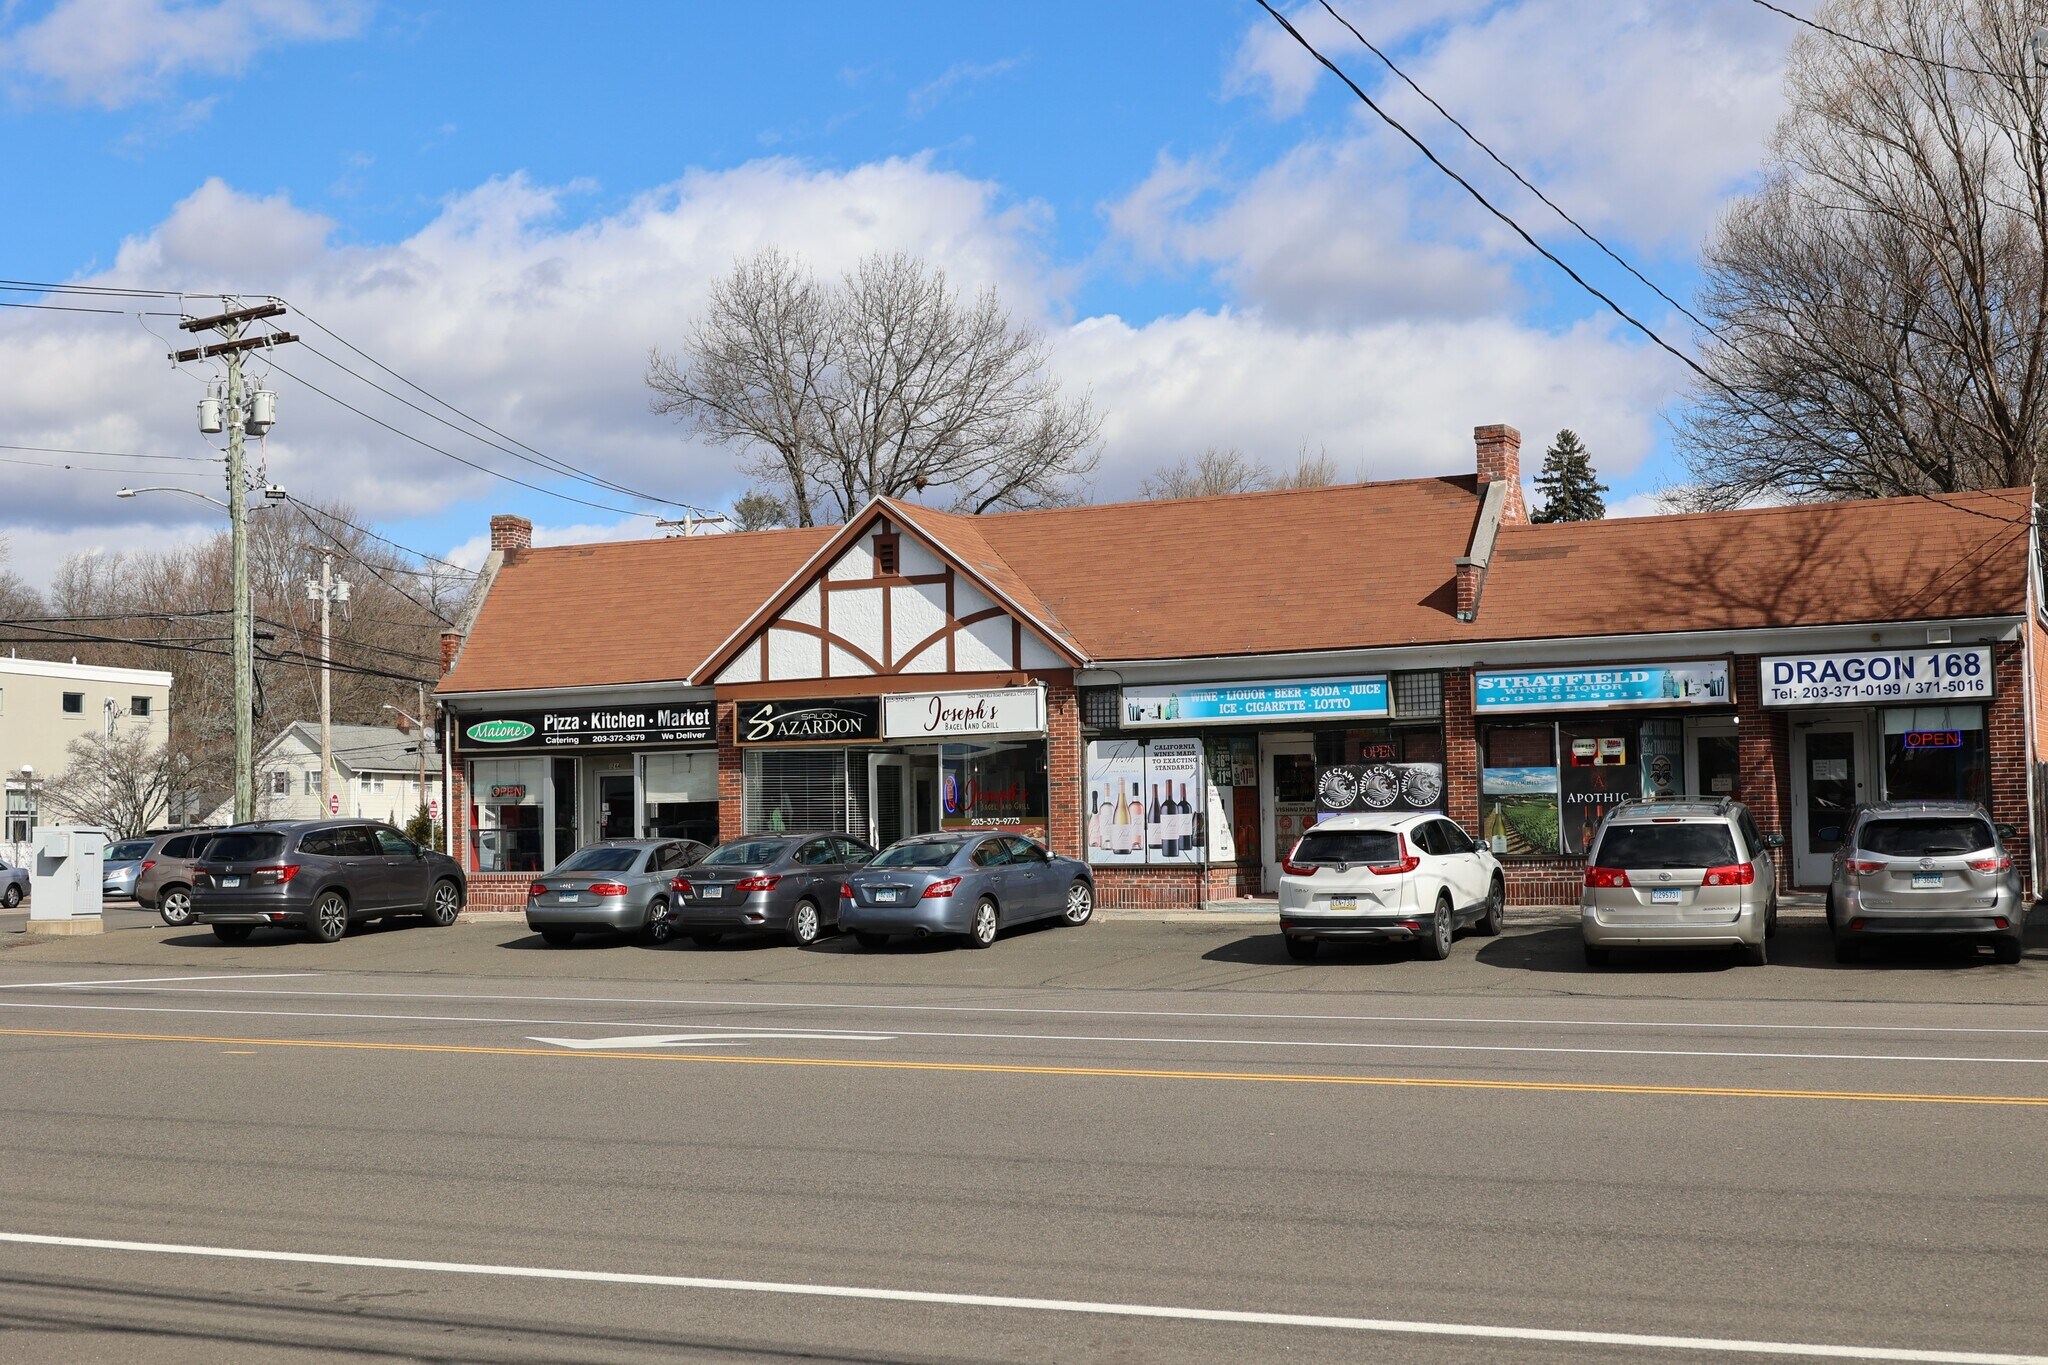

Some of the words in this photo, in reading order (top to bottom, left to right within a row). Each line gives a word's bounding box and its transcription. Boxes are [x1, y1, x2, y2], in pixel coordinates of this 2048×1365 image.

[1773, 656, 1915, 685] DRAGON
[1927, 653, 1981, 678] 168
[1477, 671, 1650, 690] STRATFIELD
[1191, 692, 1218, 702] WINE
[1226, 689, 1265, 701] LIQUOR
[1274, 688, 1302, 699] BEER
[1310, 686, 1340, 697] SODA
[1349, 684, 1381, 695] JUICE
[1504, 687, 1547, 695] WINE
[1565, 683, 1622, 692] LIQUOR
[1771, 688, 1797, 699] Tel:
[1802, 683, 1901, 699] 203-371-0199
[1915, 679, 1984, 694] 371-5016
[924, 696, 999, 731] Joseph's
[1219, 703, 1237, 714] ICE
[1245, 700, 1306, 713] CIGARETTE
[1314, 698, 1350, 710] LOTTO
[543, 714, 579, 731] Pizza
[591, 711, 645, 729] Kitchen
[657, 708, 710, 727] Market
[800, 712, 837, 720] SALON
[944, 722, 963, 731] BAGEL
[967, 722, 980, 730] AND
[981, 720, 999, 729] GRILL
[545, 736, 579, 744] Catering
[592, 734, 645, 743] 203-372-3679
[661, 732, 674, 740] We
[676, 731, 706, 740] Deliver
[1908, 732, 1958, 746] OPEN
[1154, 743, 1196, 751] CALIFORNIA
[1362, 744, 1396, 758] OPEN
[1318, 769, 1333, 795] WHITE
[1332, 767, 1355, 781] CLAW
[1359, 768, 1373, 794] WHITE
[1373, 766, 1396, 780] CLAW
[1401, 767, 1415, 793] WHITE
[492, 786, 522, 797] OPEN
[1566, 792, 1630, 803] APOTHIC
